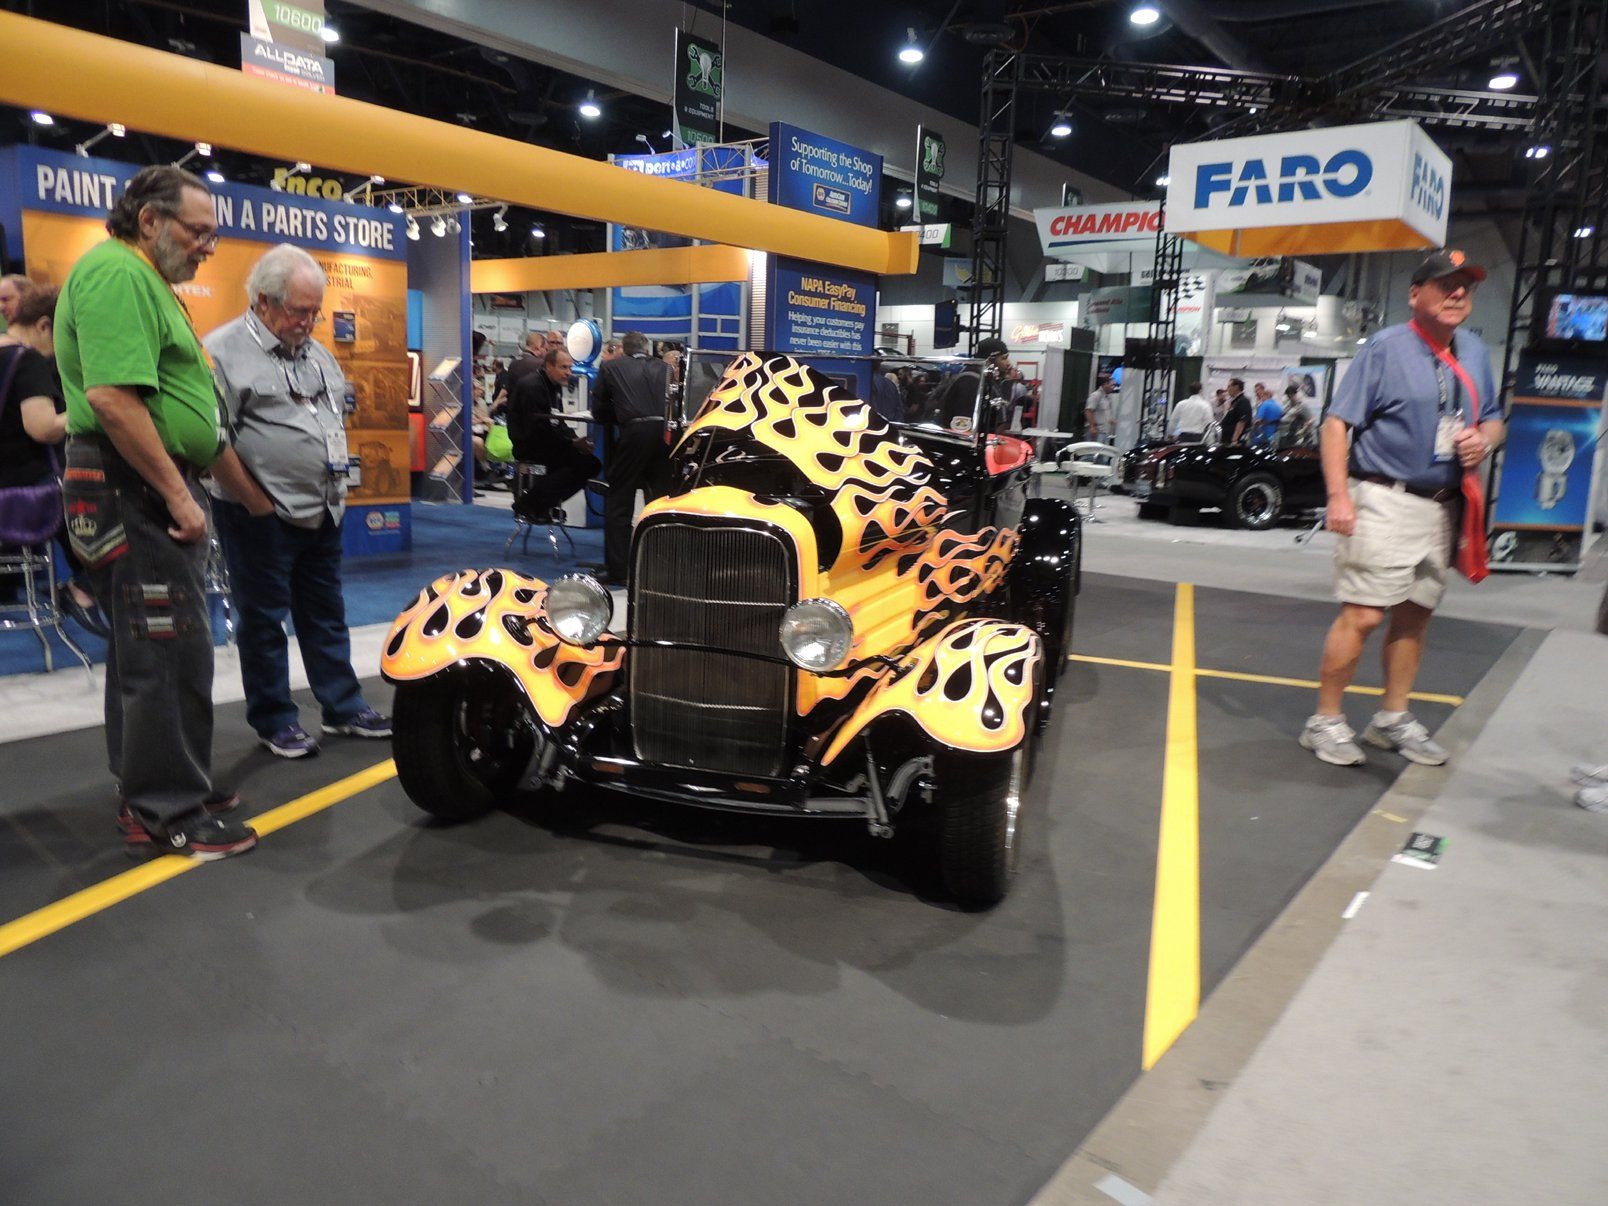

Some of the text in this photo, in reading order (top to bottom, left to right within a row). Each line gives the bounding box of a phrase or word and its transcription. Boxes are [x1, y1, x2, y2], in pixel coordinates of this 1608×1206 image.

[274, 4, 321, 33] 10600
[254, 43, 324, 75] ALLDATA
[791, 136, 873, 176] Supporting the Shop
[790, 158, 873, 195] of Tomorrow...Today!
[1194, 150, 1373, 209] FARO
[1411, 152, 1444, 221] FARO
[37, 164, 116, 210] PAINT
[240, 199, 256, 231] A
[262, 202, 328, 241] PARTS
[333, 214, 394, 251] STORE
[1050, 211, 1164, 237] CHAMPIO
[319, 261, 373, 279] NUFACTURING,
[326, 275, 353, 289] STRIAL
[801, 277, 856, 301] NAPA EasyPay
[788, 290, 866, 317] Consumer Financing
[788, 311, 812, 325] Helping
[812, 316, 826, 325] your
[854, 321, 865, 331] pay
[792, 323, 819, 335] insurance
[790, 337, 862, 351] never been easier with this
